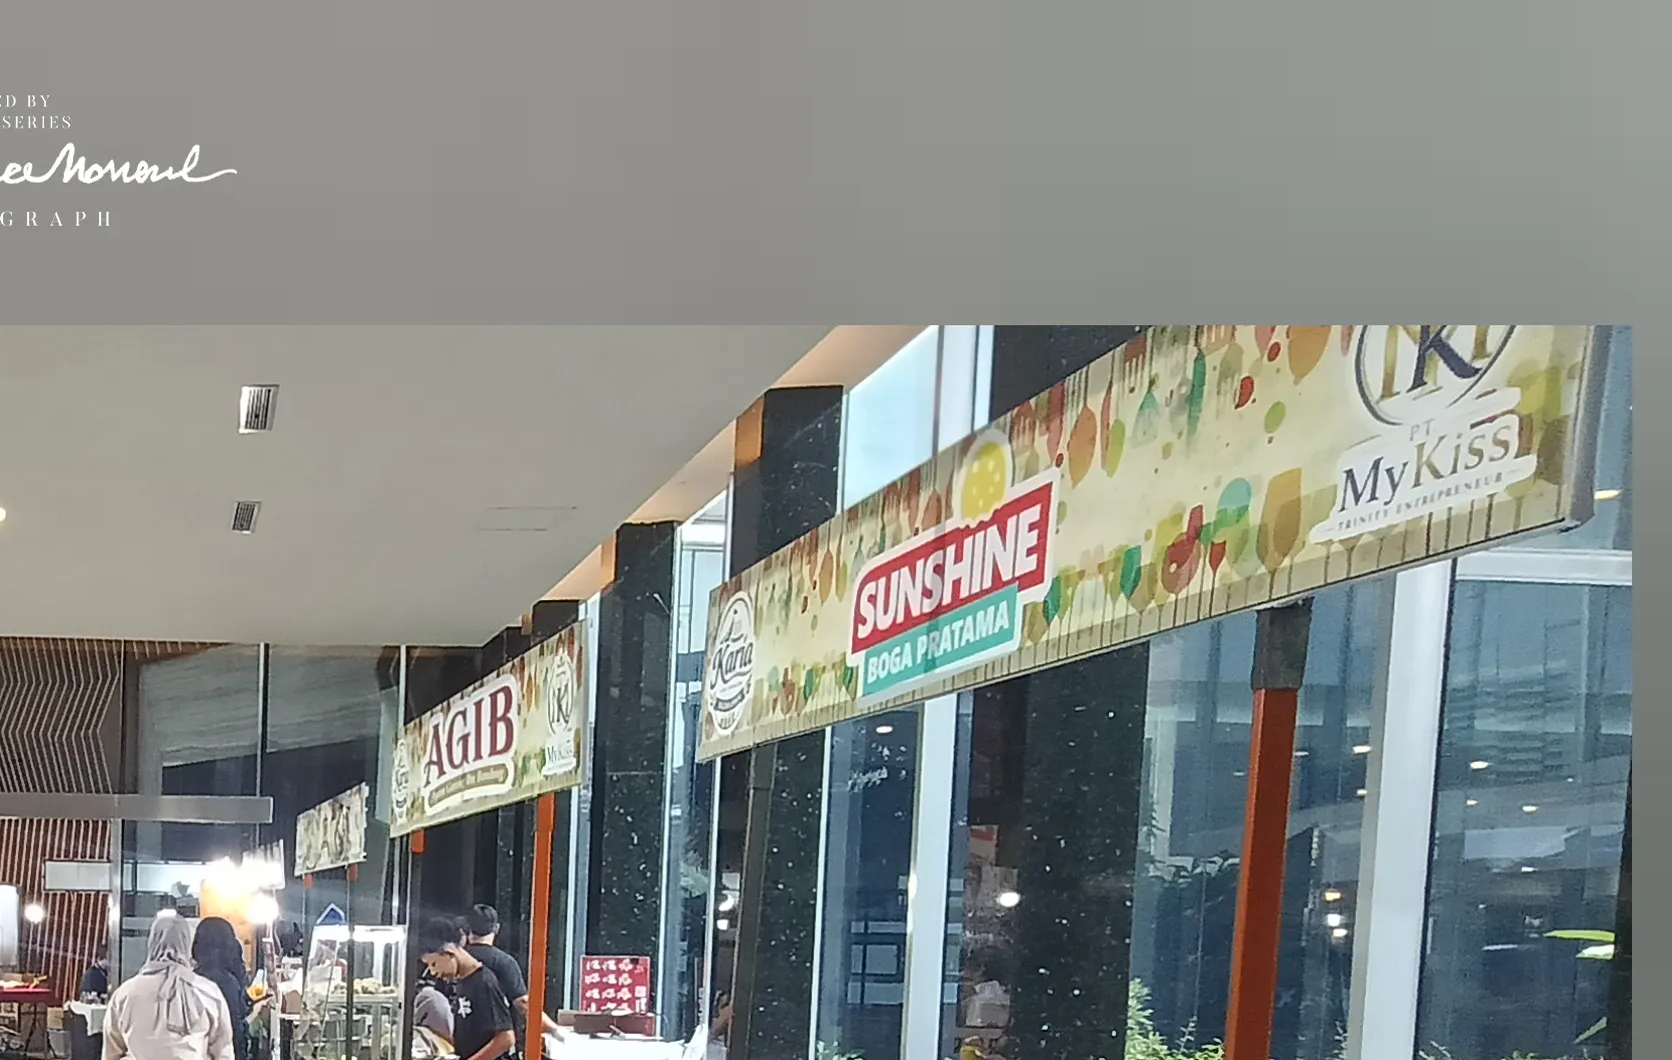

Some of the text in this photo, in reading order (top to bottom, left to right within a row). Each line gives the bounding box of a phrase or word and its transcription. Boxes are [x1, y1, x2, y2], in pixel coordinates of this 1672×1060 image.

[1338, 424, 1512, 513] MyKiss
[857, 504, 1042, 640] SUNSHINE
[710, 642, 755, 691] Karia
[867, 600, 1011, 685] BOGA PRATAMA
[423, 685, 515, 789] AGIB
